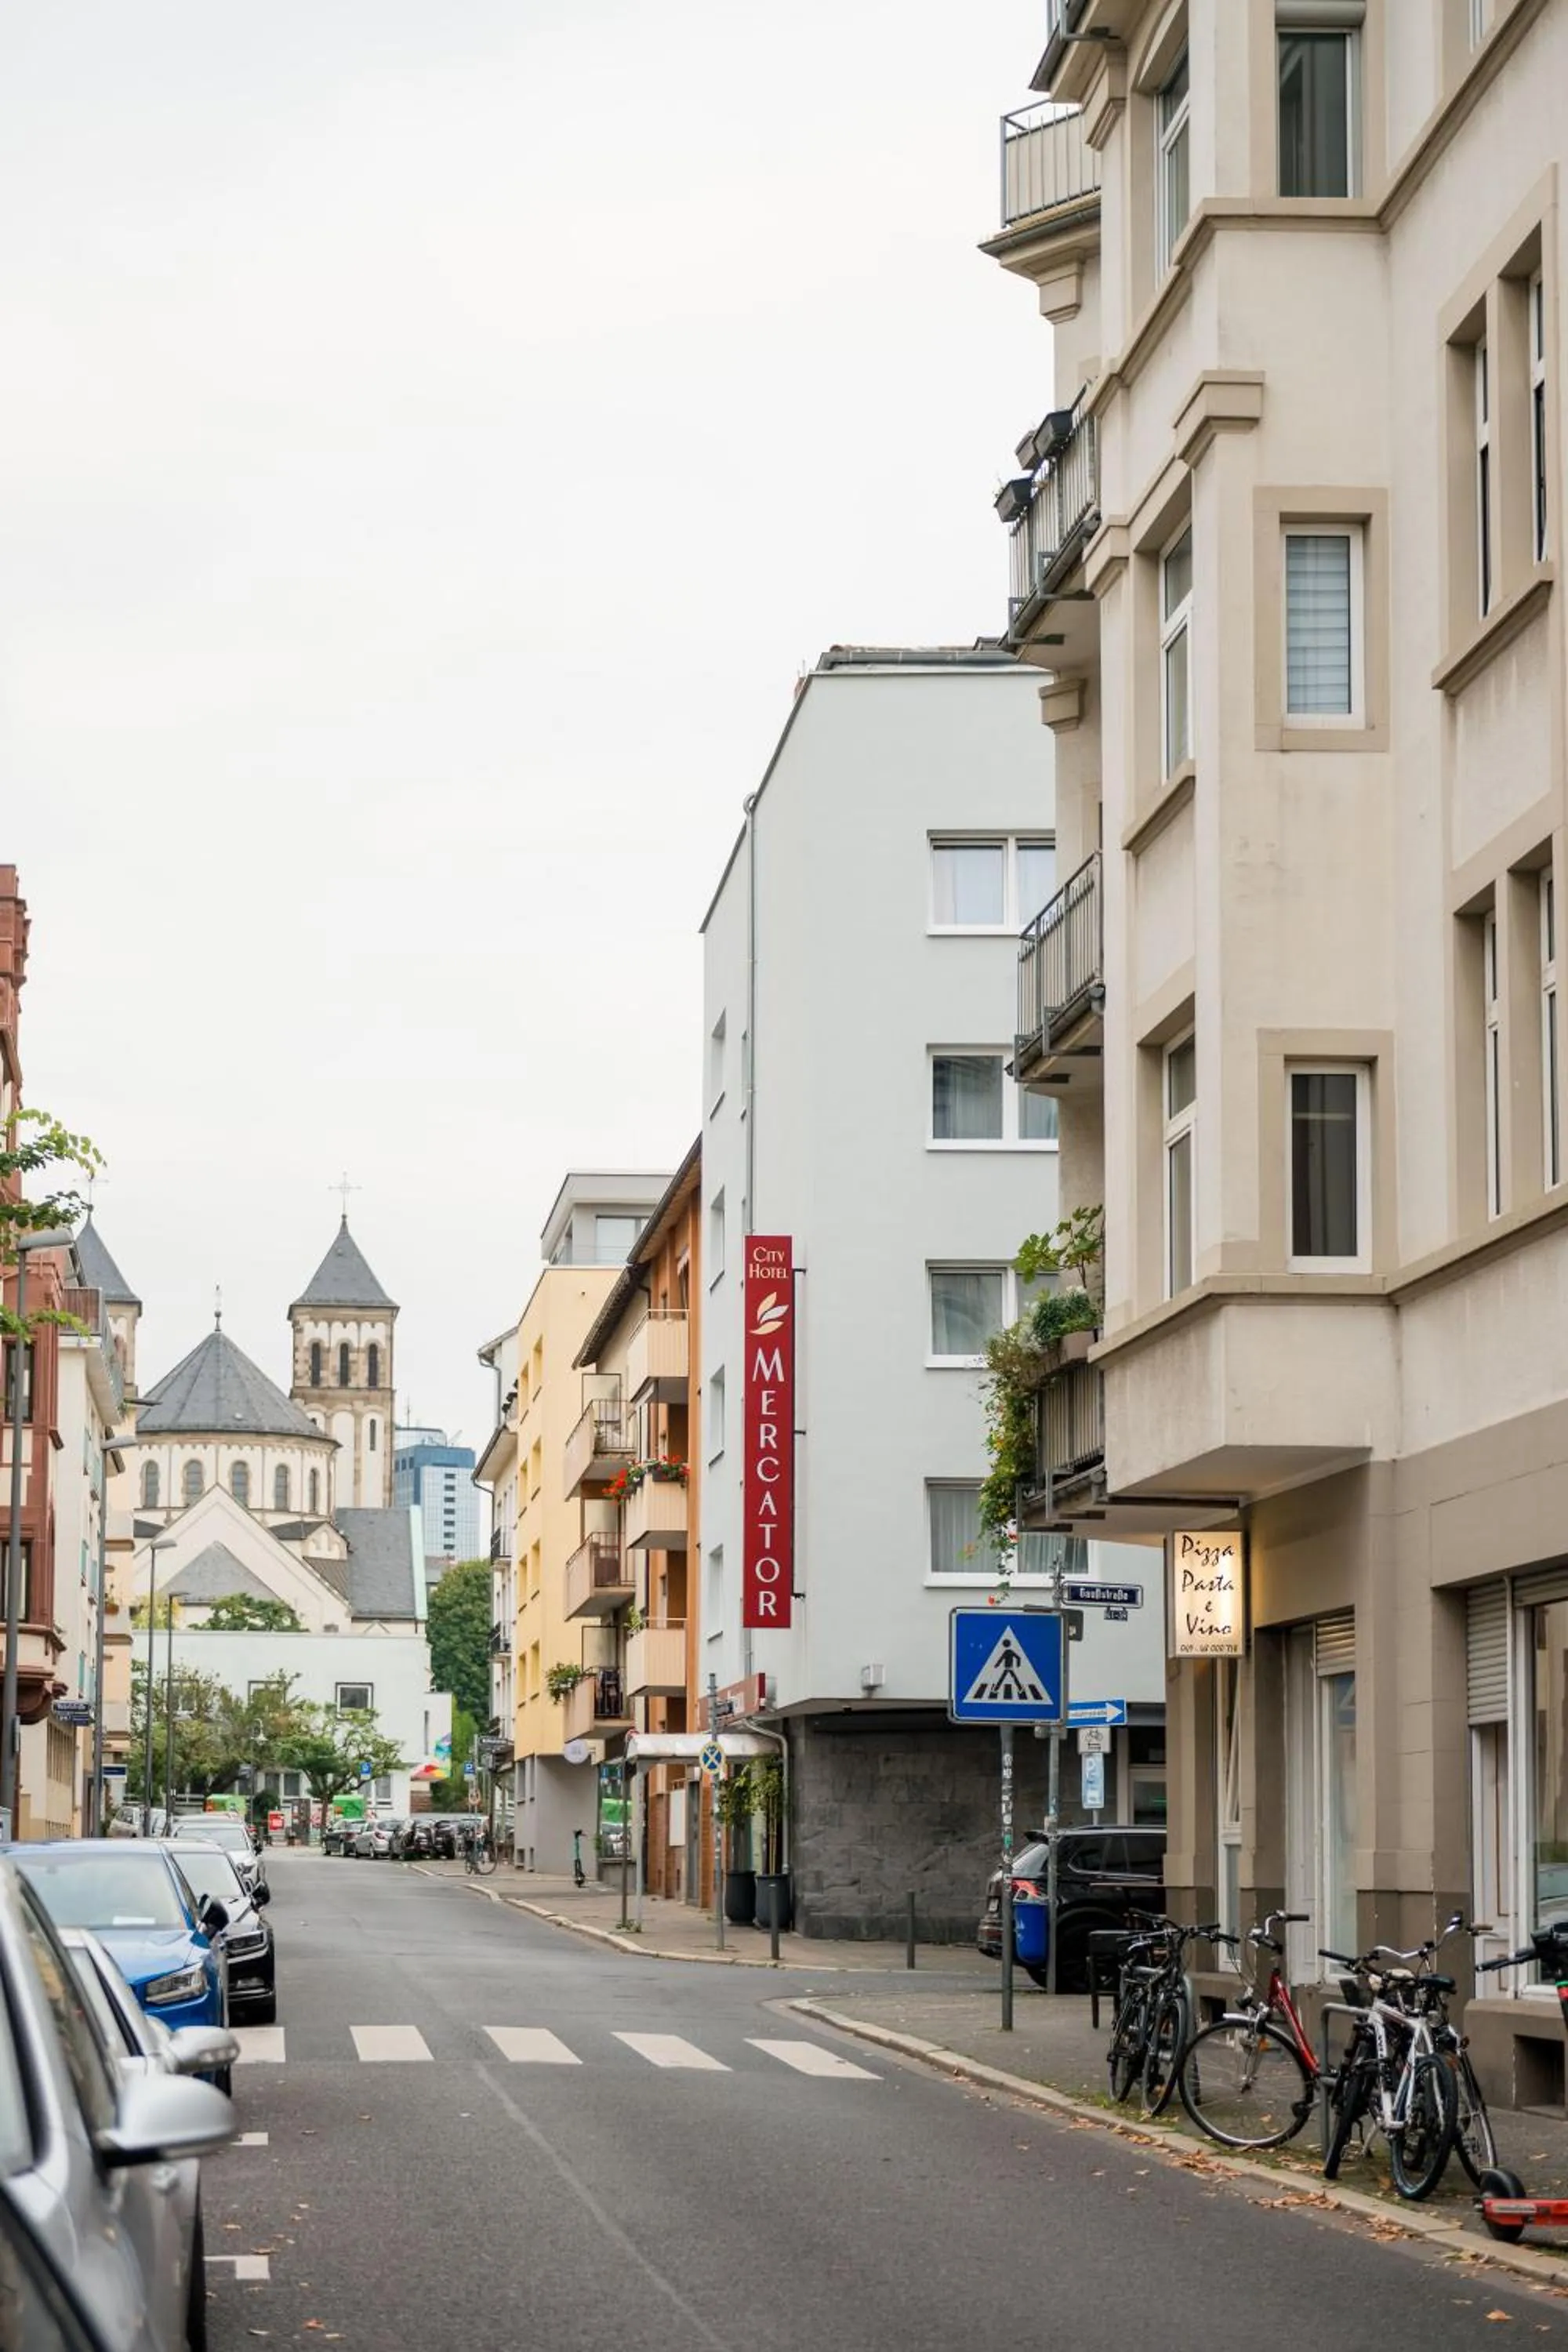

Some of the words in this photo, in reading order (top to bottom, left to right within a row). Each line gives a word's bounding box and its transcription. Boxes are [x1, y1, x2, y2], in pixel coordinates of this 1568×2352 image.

[749, 1263, 789, 1279] HOTEL
[752, 1347, 784, 1617] MERCATOR
[1181, 1534, 1235, 1566] Pizza
[1181, 1569, 1235, 1592] Pasta
[1205, 1600, 1213, 1613] e
[1186, 1613, 1232, 1636] Vino
